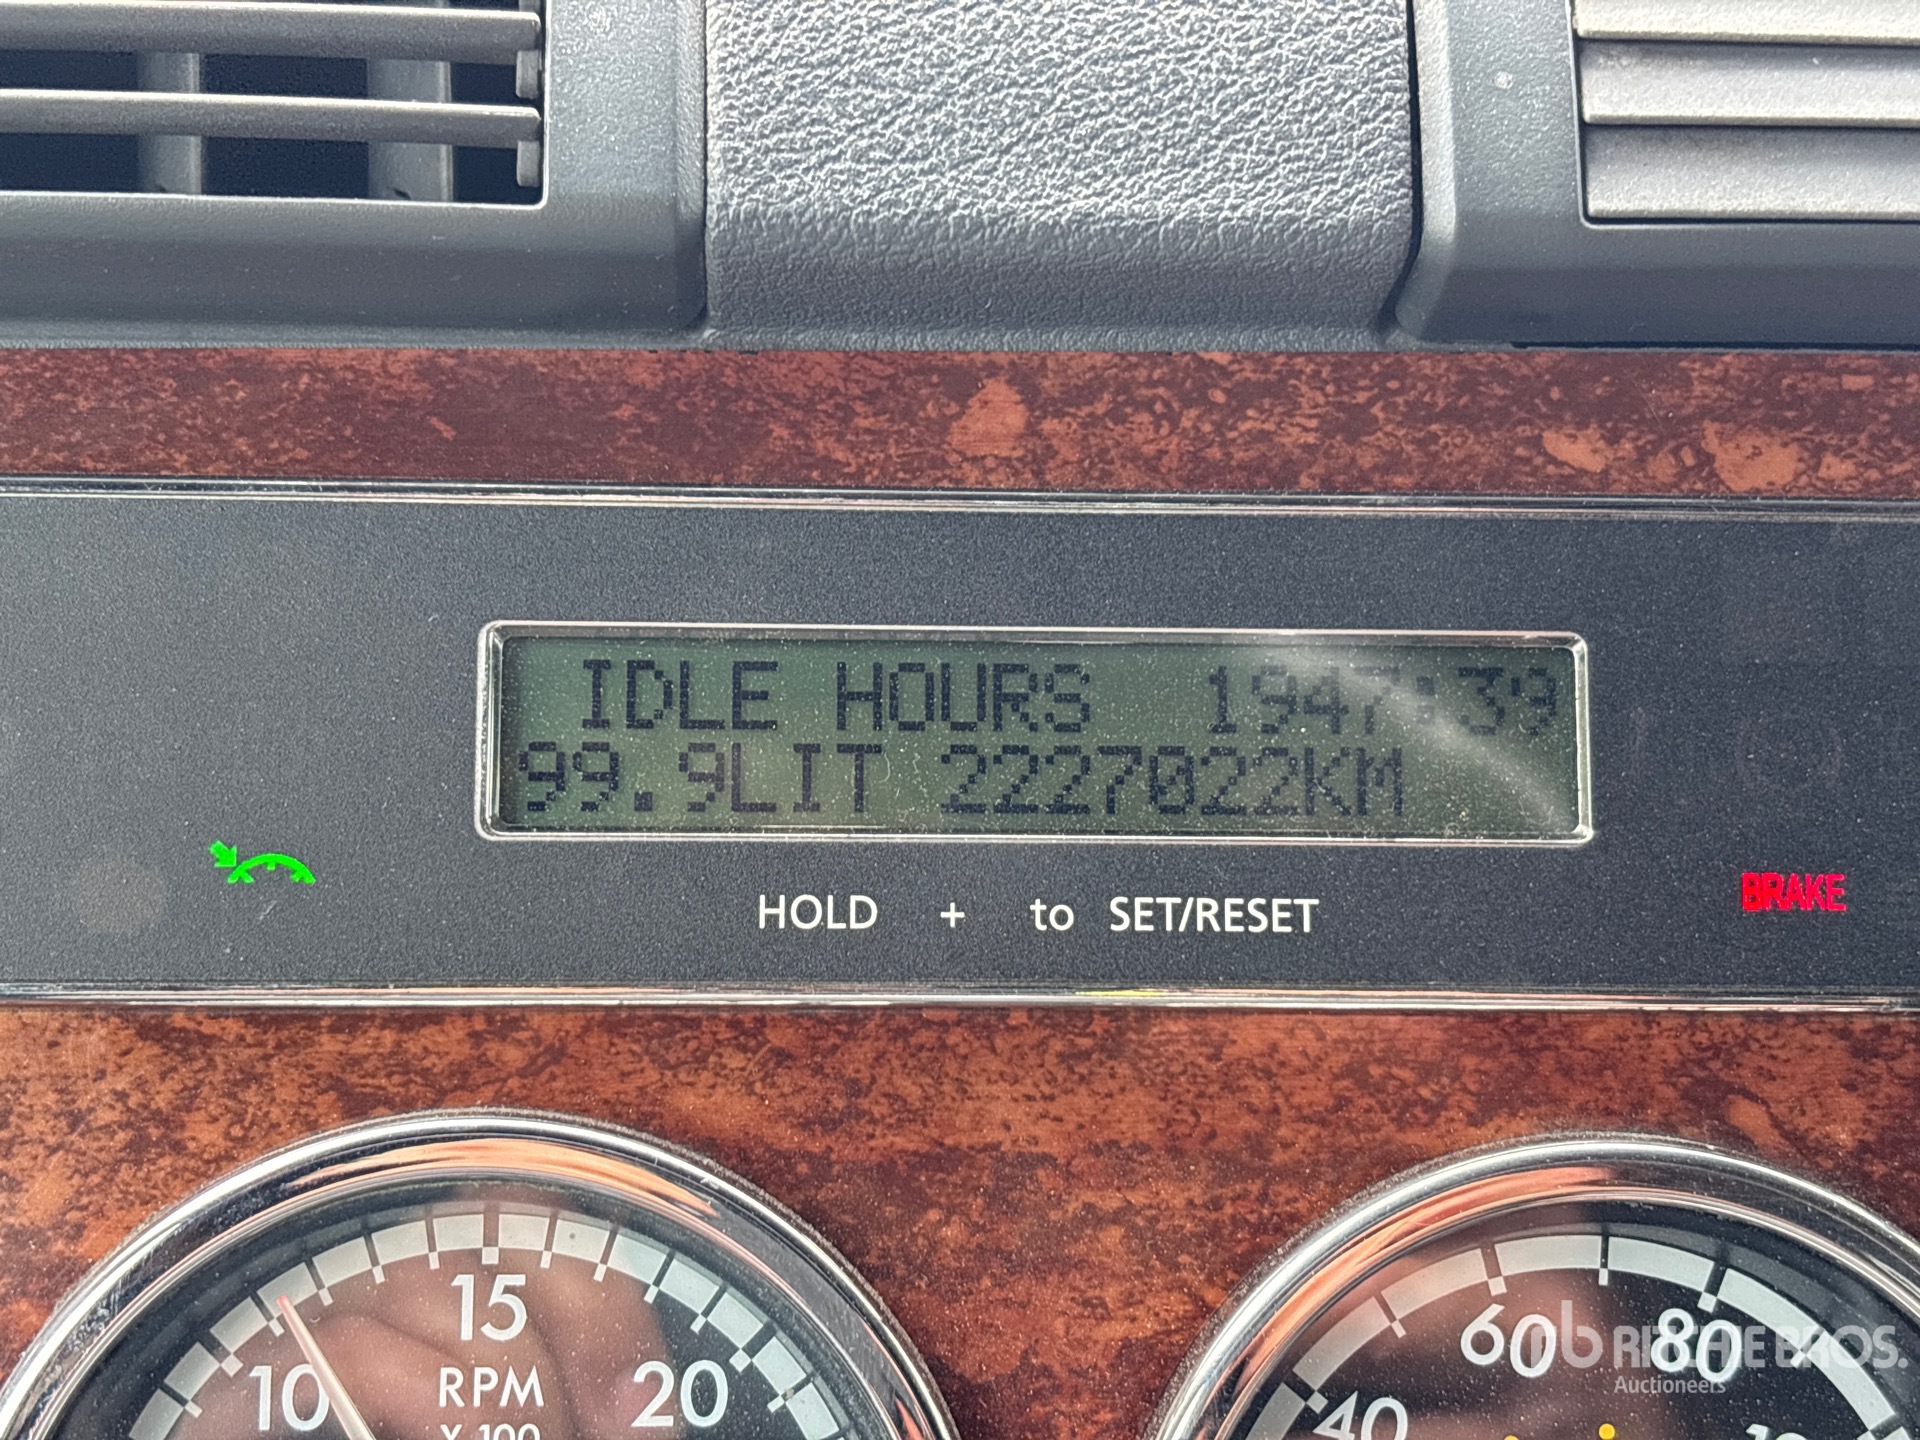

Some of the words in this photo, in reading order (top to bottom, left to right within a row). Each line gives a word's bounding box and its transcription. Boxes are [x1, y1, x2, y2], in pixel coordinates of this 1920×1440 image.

[582, 660, 778, 730] IDLE
[837, 662, 1090, 732] HOURS
[1208, 665, 1557, 736] 1947:39
[518, 741, 882, 813] 99.9LIT
[940, 743, 1401, 816] 2227022KM
[758, 894, 878, 930] HOLD
[1029, 898, 1075, 932] to
[1109, 896, 1320, 934] SET/RESET
[1741, 872, 1847, 912] BRAKE
[450, 1274, 528, 1341] 15
[1460, 1303, 1557, 1378] 60
[1650, 1308, 1742, 1383] 80
[248, 1365, 330, 1431] 10
[438, 1365, 544, 1407] RPM
[630, 1360, 729, 1428] 20
